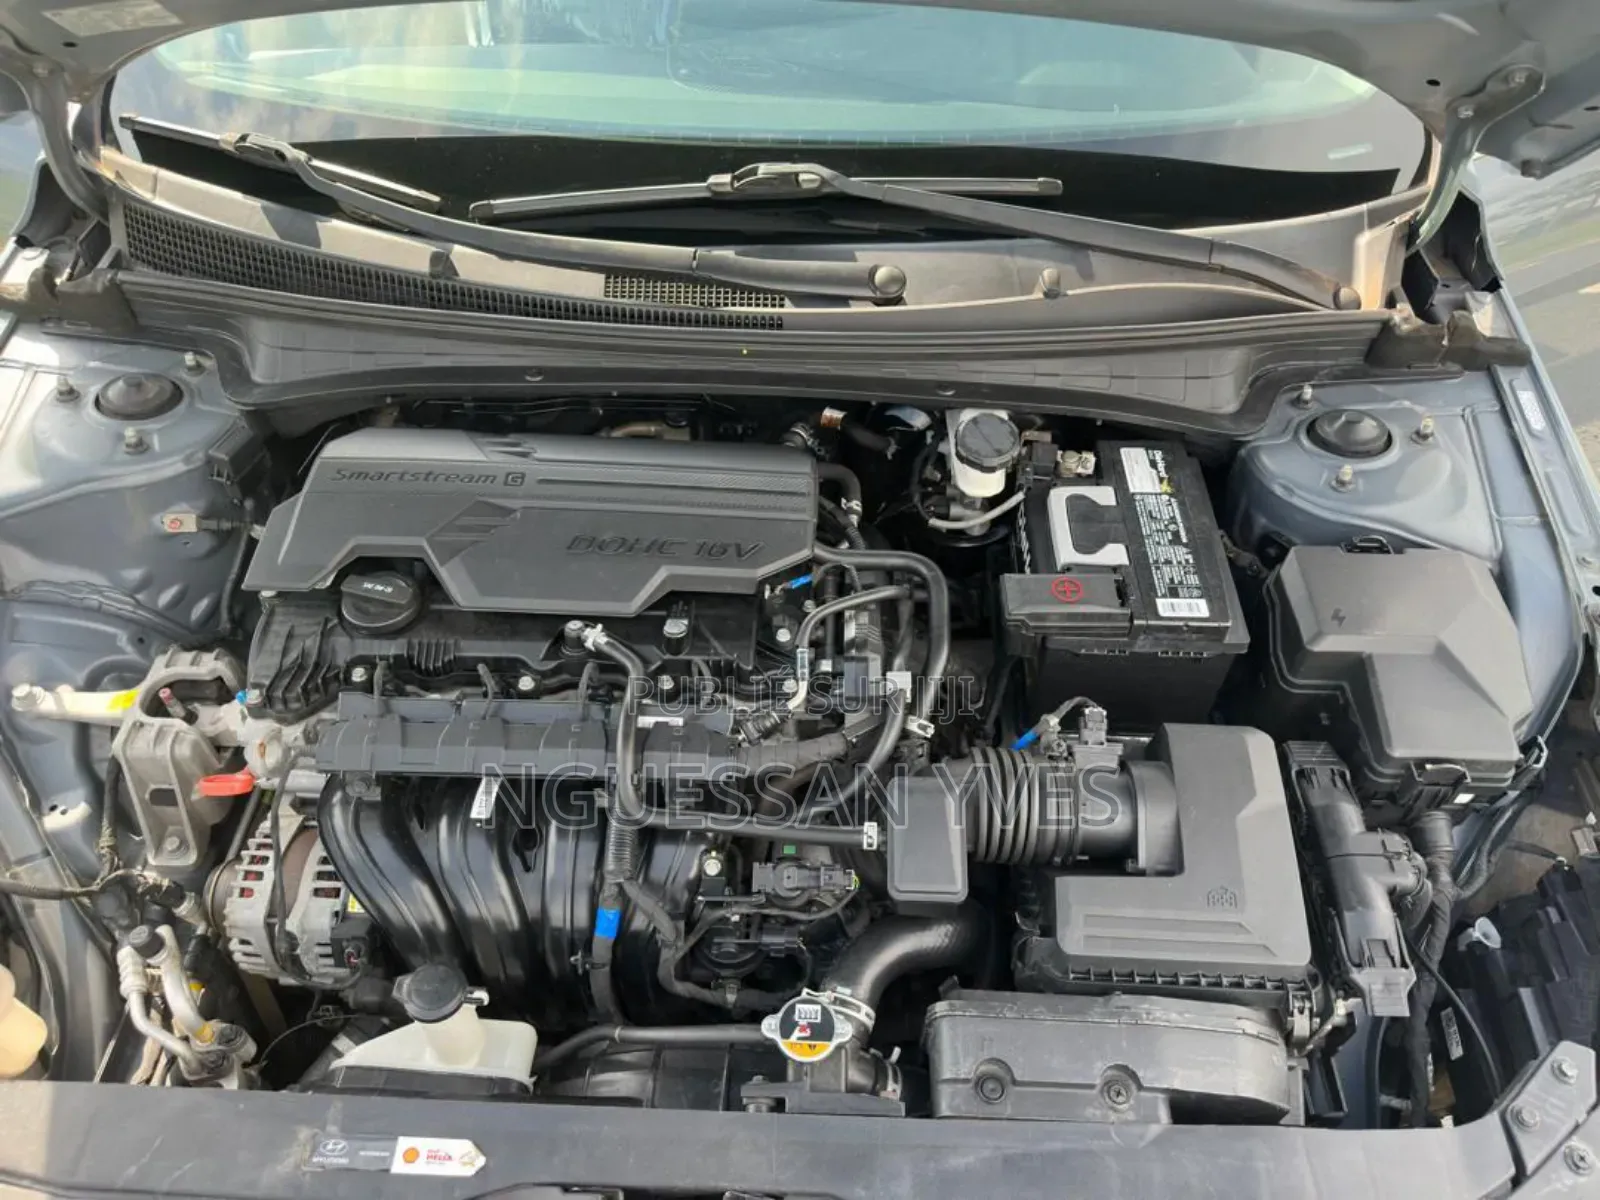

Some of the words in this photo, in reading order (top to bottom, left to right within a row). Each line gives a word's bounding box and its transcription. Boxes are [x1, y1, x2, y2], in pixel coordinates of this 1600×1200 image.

[331, 468, 497, 484] Smartstream
[566, 534, 688, 557] DOHC
[694, 537, 764, 560] 16V
